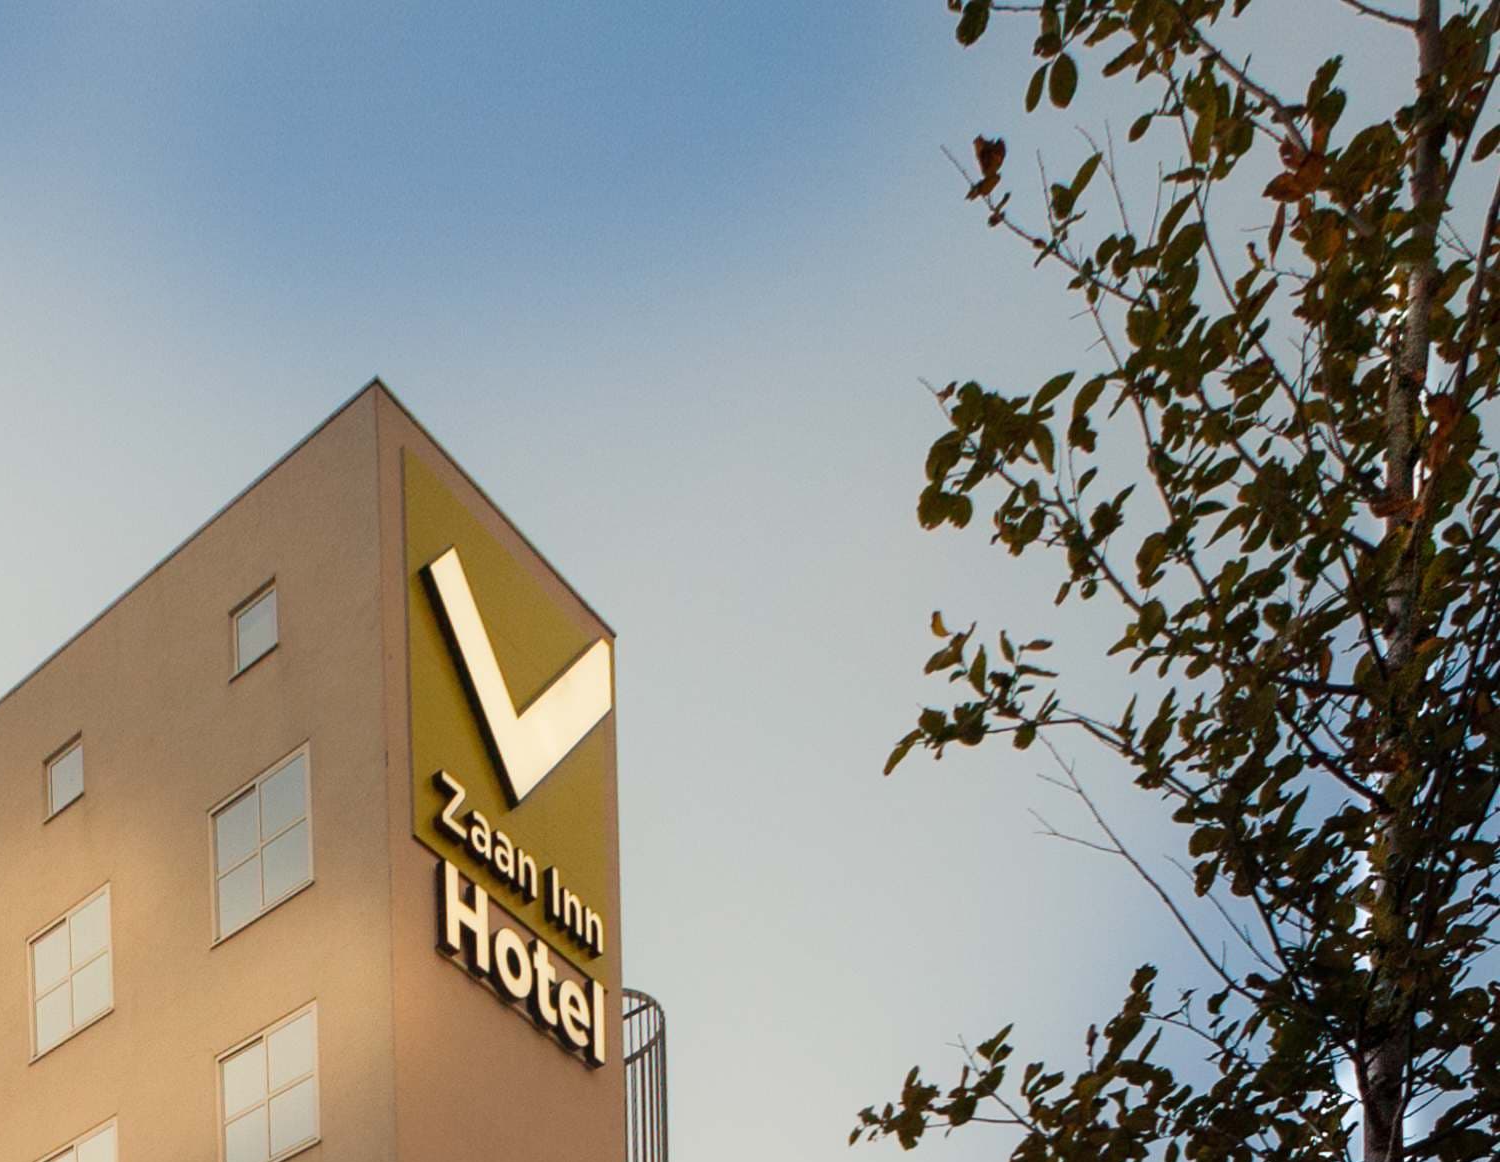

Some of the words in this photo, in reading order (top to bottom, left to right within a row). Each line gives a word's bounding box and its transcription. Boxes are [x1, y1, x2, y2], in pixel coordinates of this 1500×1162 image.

[436, 770, 537, 901] Zaan
[548, 866, 604, 956] Inn
[440, 859, 606, 1066] Hotel
